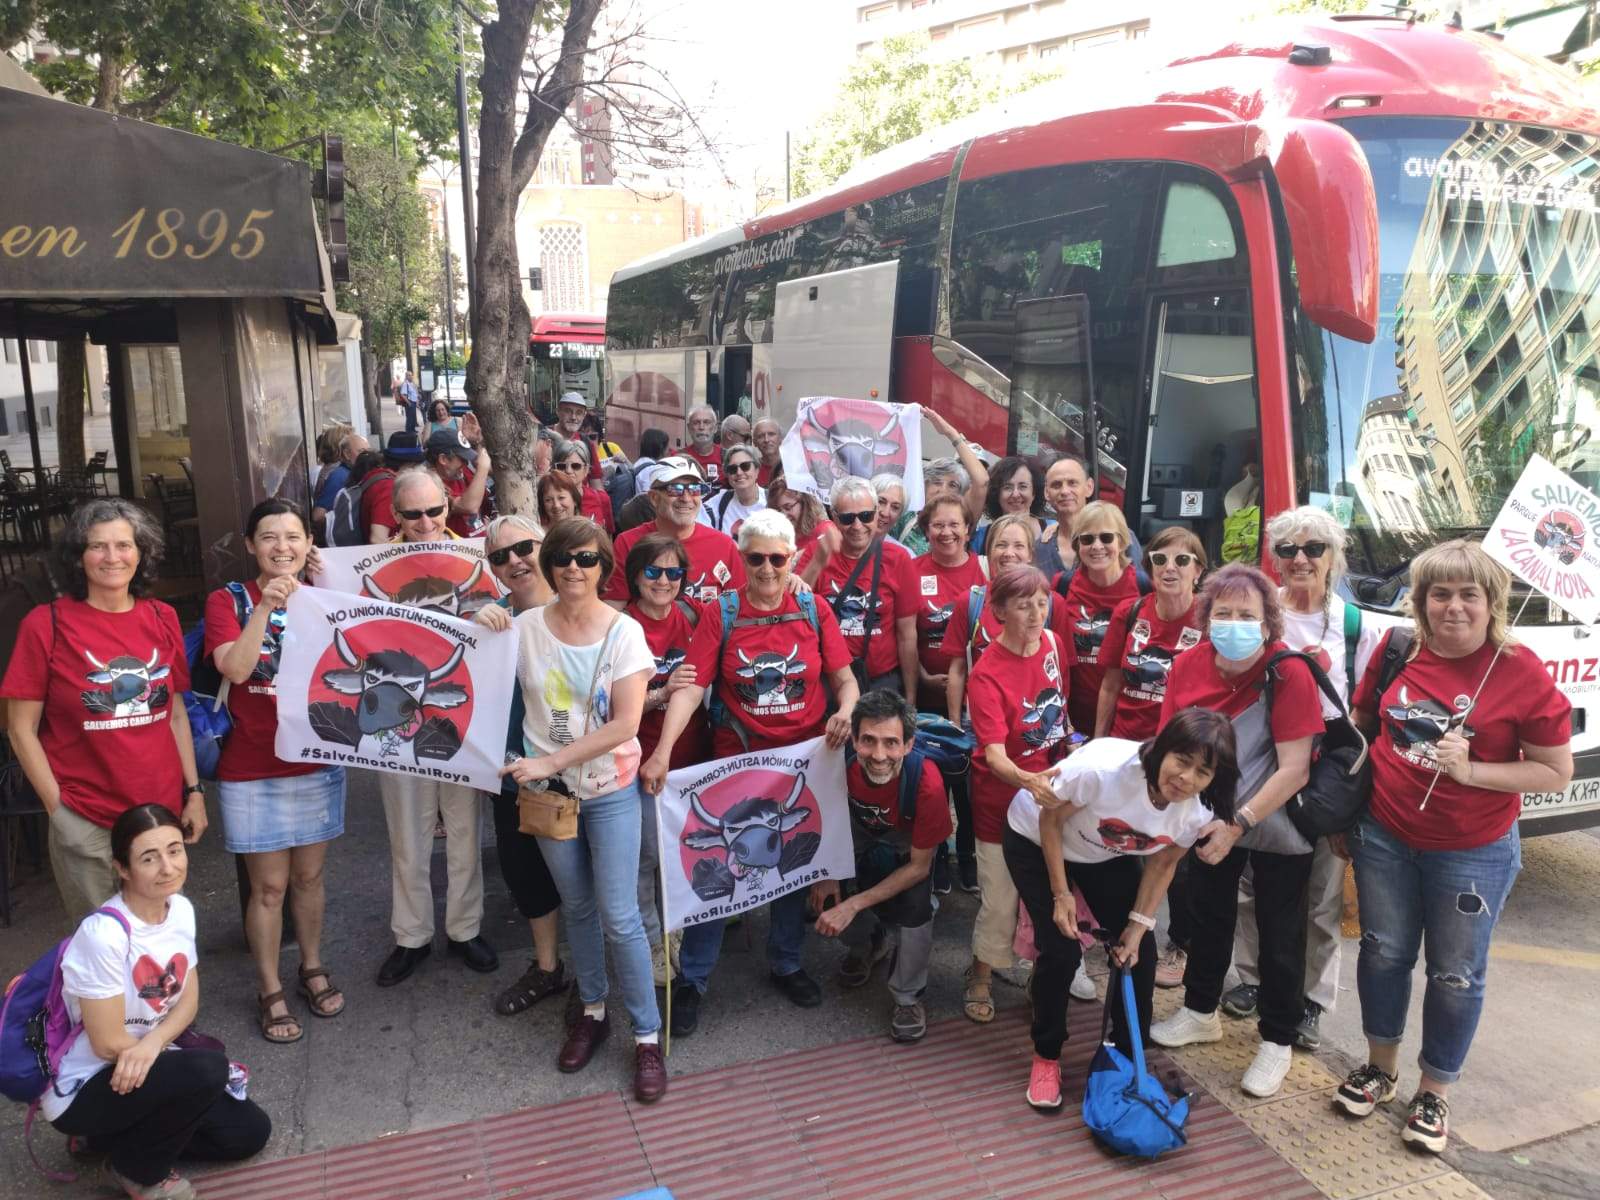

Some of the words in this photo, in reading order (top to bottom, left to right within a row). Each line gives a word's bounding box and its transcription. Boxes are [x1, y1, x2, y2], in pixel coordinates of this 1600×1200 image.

[1, 225, 87, 259] en
[112, 207, 274, 260] 1895
[715, 236, 796, 275] avanzabus.com
[549, 343, 563, 358] 23
[1500, 528, 1529, 548] LA
[1510, 499, 1538, 522] PARQUE
[1581, 551, 1600, 569] NATU
[352, 558, 372, 574] NO
[372, 546, 406, 563] UNIÓN
[1510, 548, 1551, 591] CANAL
[1554, 571, 1595, 600] ROYA
[326, 610, 347, 625] NO
[349, 603, 384, 619] UNIÓN
[386, 606, 478, 649] ASTÚN-FORMIGAL
[83, 718, 129, 731] SALVEMOS
[300, 747, 470, 783] #SalvemosCanalRoya
[1569, 781, 1600, 802] KXR
